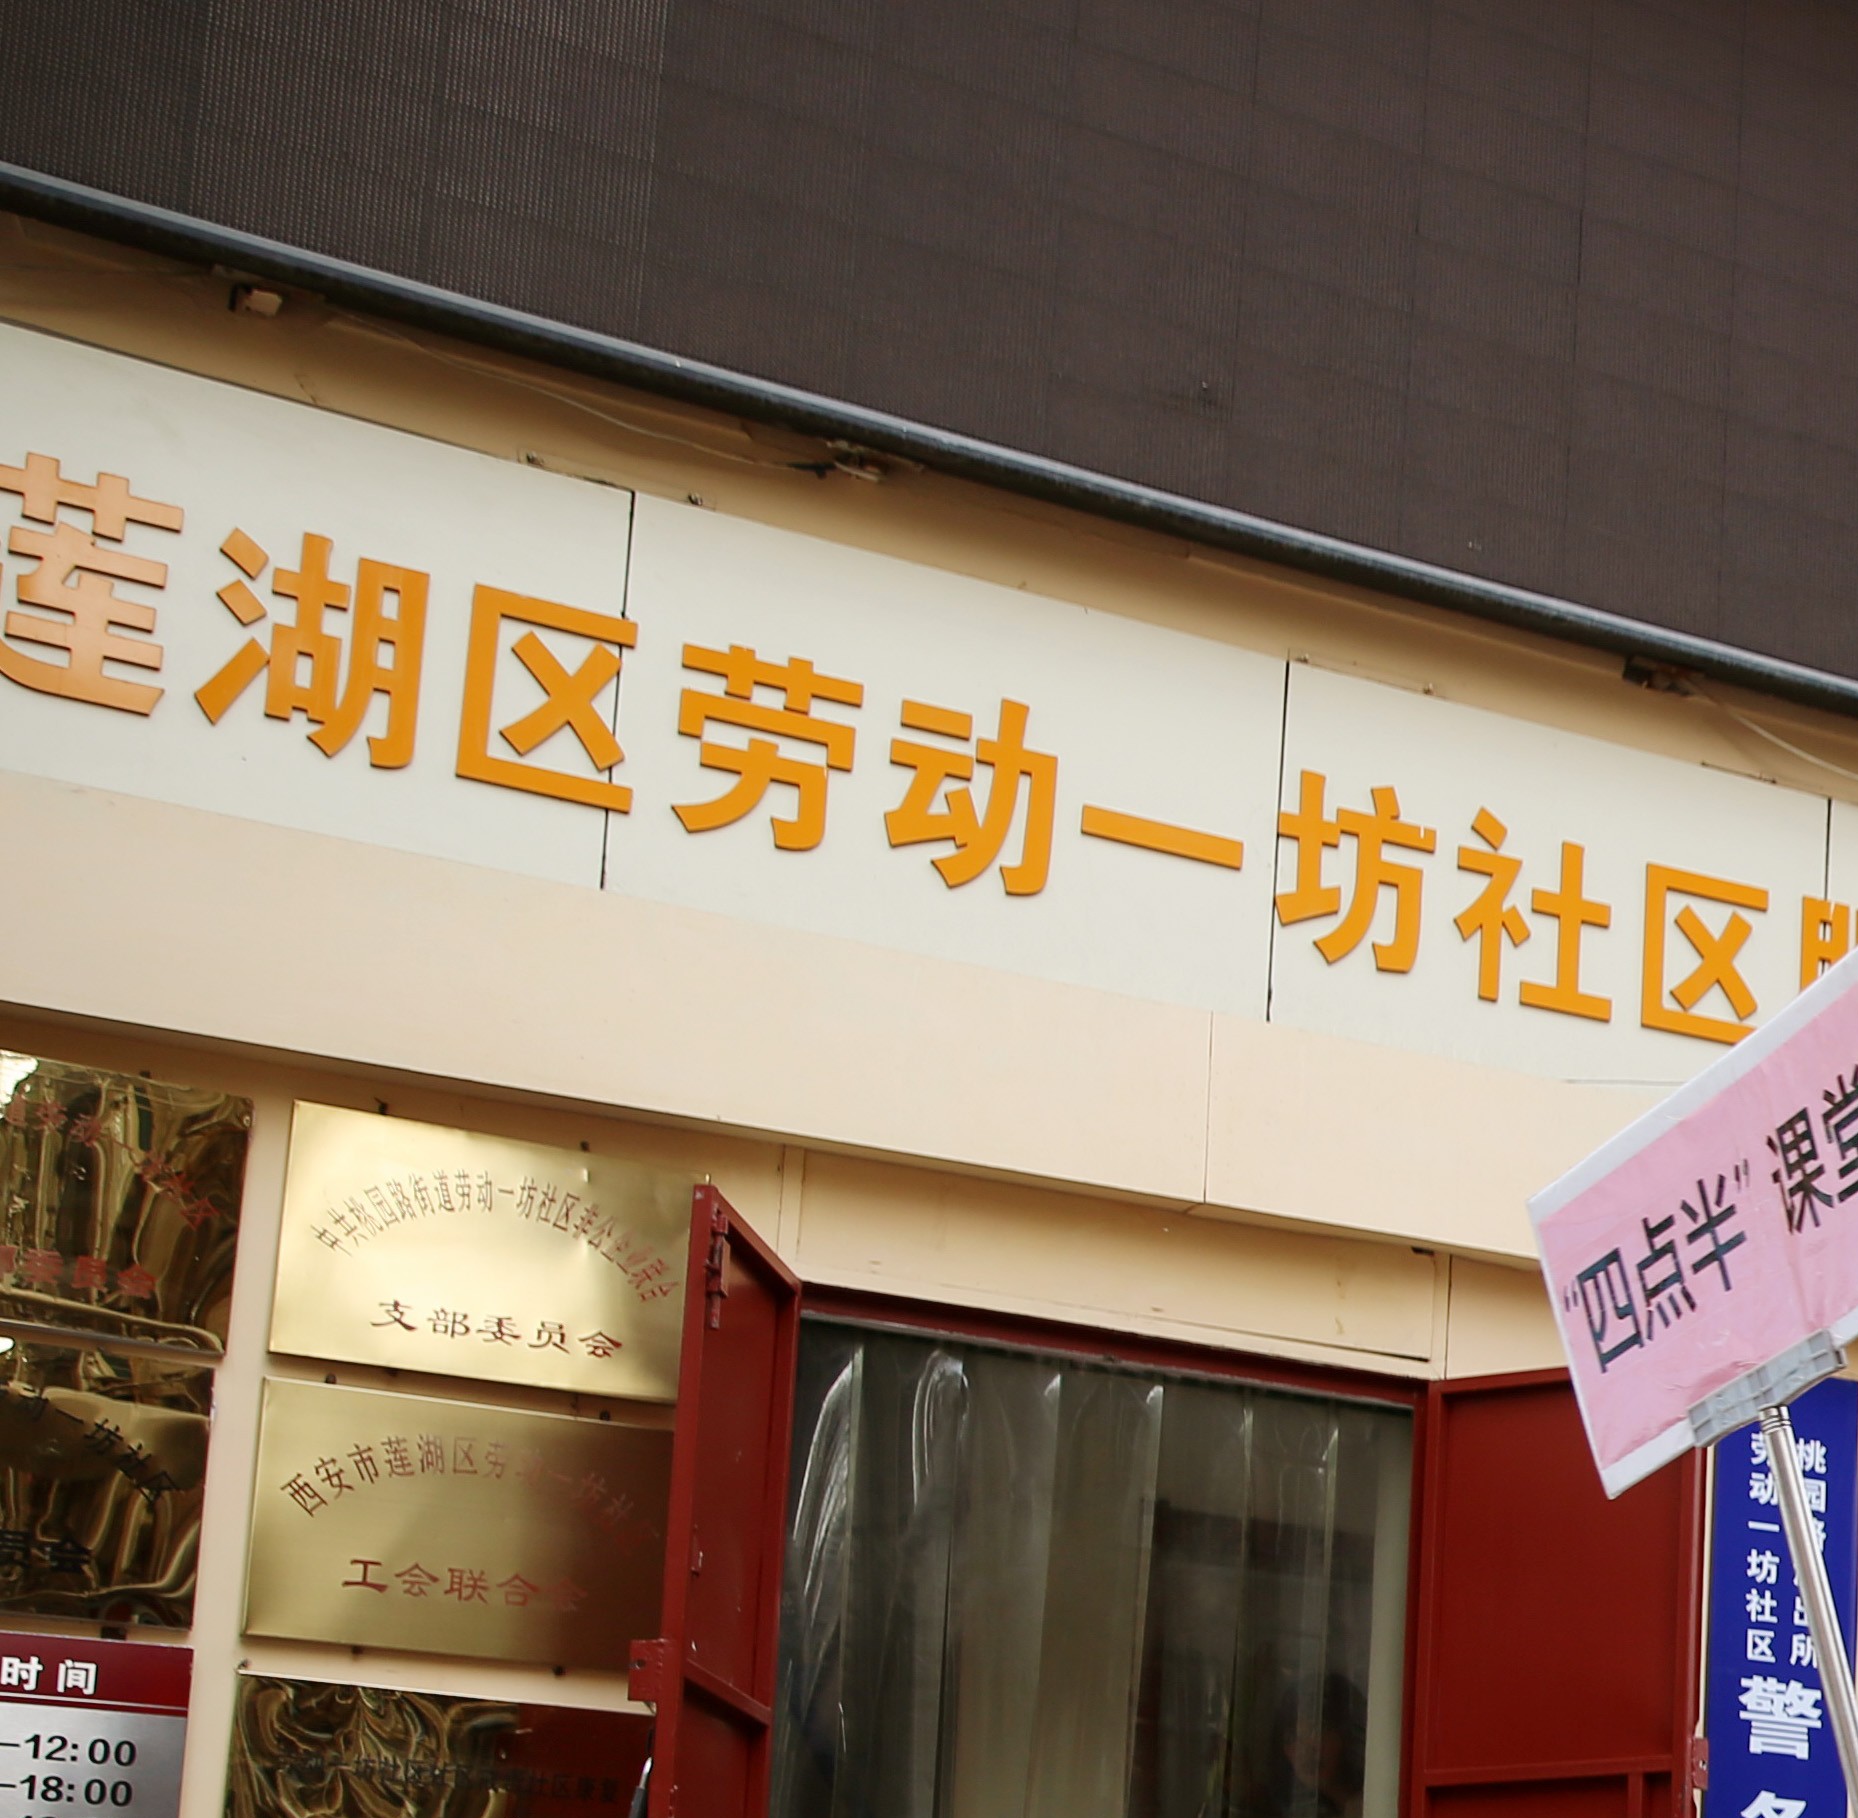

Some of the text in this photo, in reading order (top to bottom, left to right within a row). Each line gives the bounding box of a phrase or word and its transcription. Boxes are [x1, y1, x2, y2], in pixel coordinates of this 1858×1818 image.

[369, 1298, 624, 1360] 支部委员会
[1745, 1431, 1781, 1665] 劳动一坊社区
[341, 1558, 589, 1612] 工会联合会
